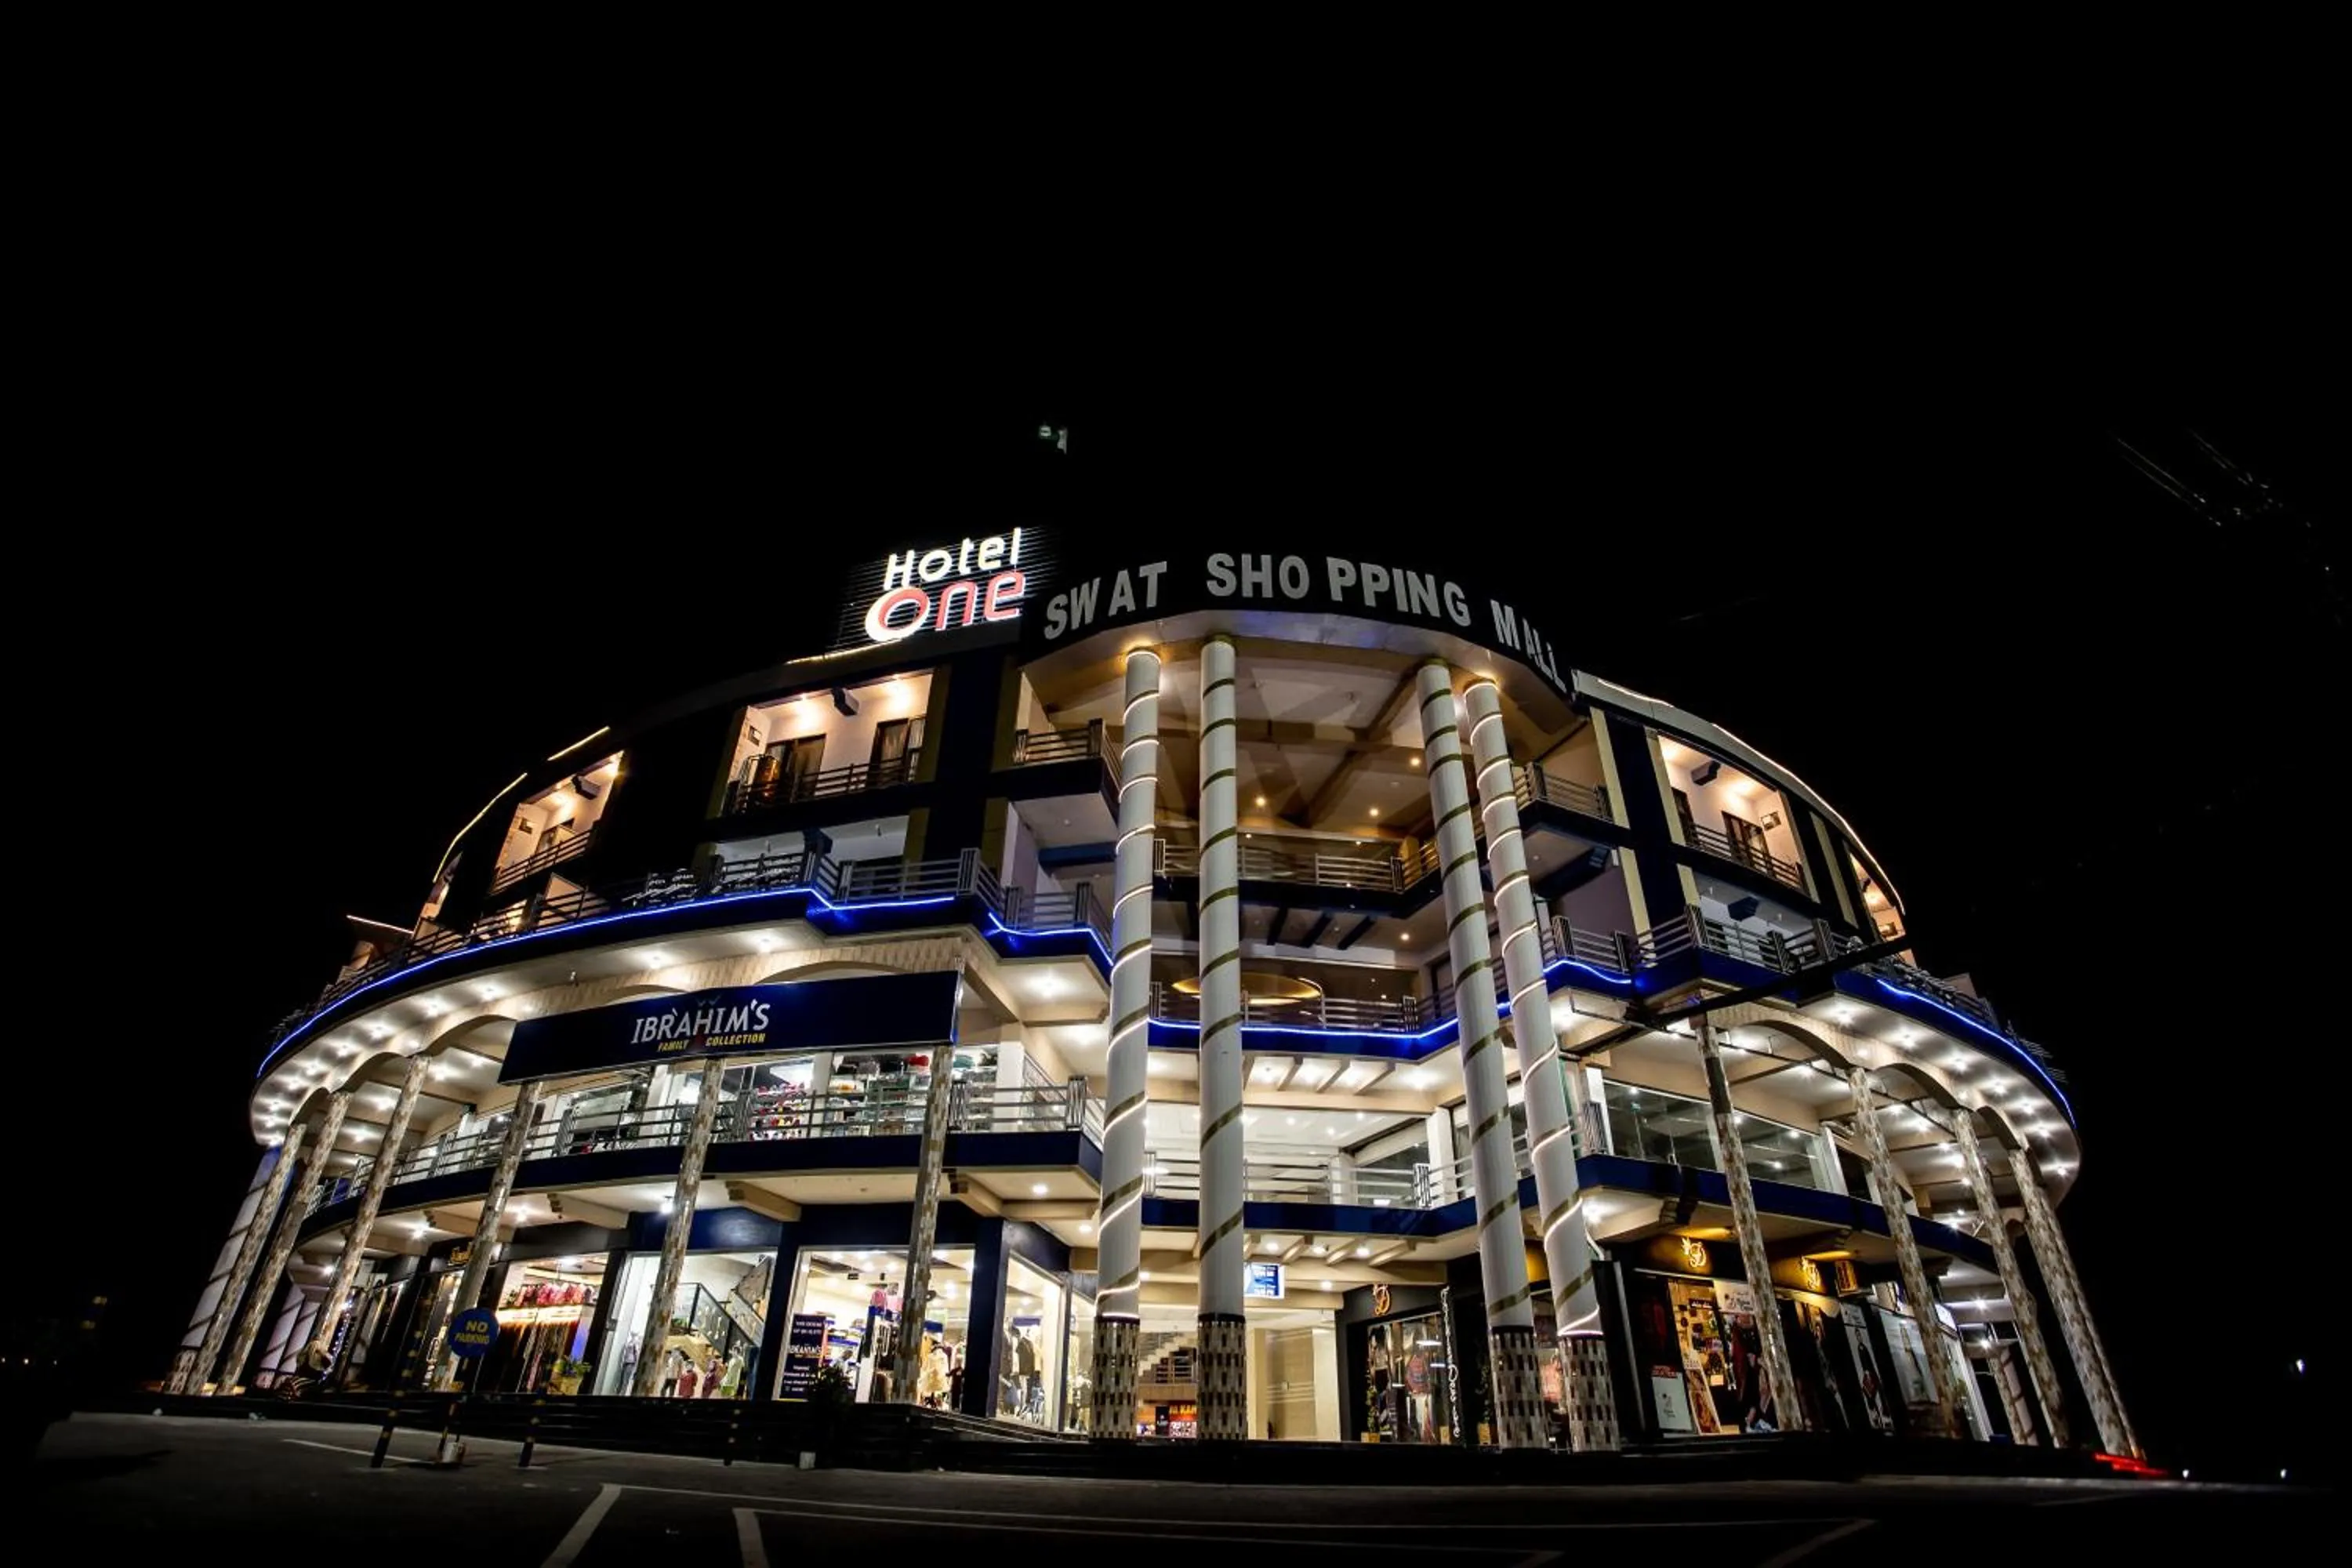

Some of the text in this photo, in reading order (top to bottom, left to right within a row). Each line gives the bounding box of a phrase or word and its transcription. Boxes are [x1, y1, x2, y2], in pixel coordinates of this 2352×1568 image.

[884, 527, 1022, 590] Hotel
[865, 568, 1026, 641] One
[1044, 561, 1167, 640] SWAT
[1490, 599, 1567, 694] MALL
[657, 1033, 766, 1051] FAMILY COLLECTION
[466, 1319, 488, 1333] NO
